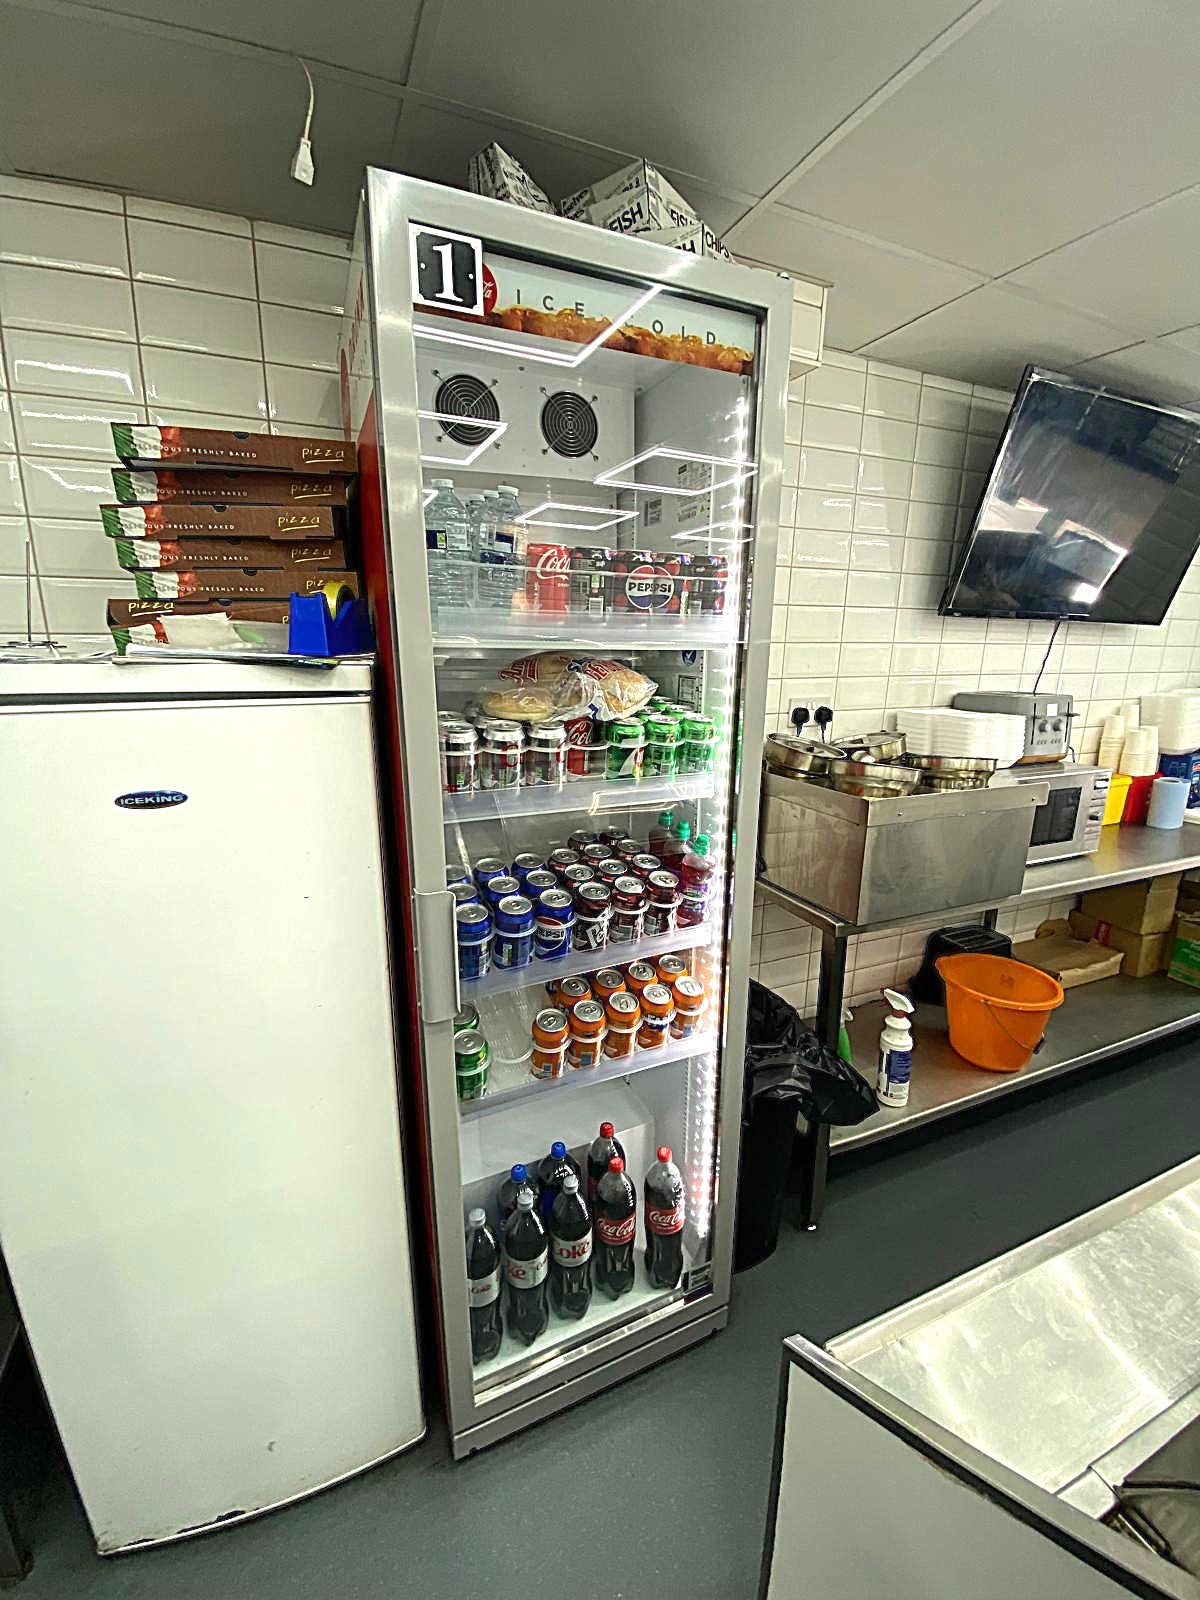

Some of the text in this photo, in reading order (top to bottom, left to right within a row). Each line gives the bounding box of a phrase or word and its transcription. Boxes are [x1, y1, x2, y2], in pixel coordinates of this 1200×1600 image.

[608, 201, 645, 233] FISH
[432, 242, 464, 302] 1
[517, 288, 585, 318] ICE
[186, 447, 225, 456] FRESHLY
[228, 450, 257, 459] BAKED
[302, 443, 345, 462] pizza
[291, 484, 333, 496] pizza
[278, 511, 321, 528] pizza
[207, 523, 236, 531] BAKED
[291, 548, 333, 559] pizza
[199, 585, 235, 593] FRESHLY
[306, 575, 326, 591] piz
[128, 601, 175, 613] pizza
[120, 793, 184, 805] ICEKING
